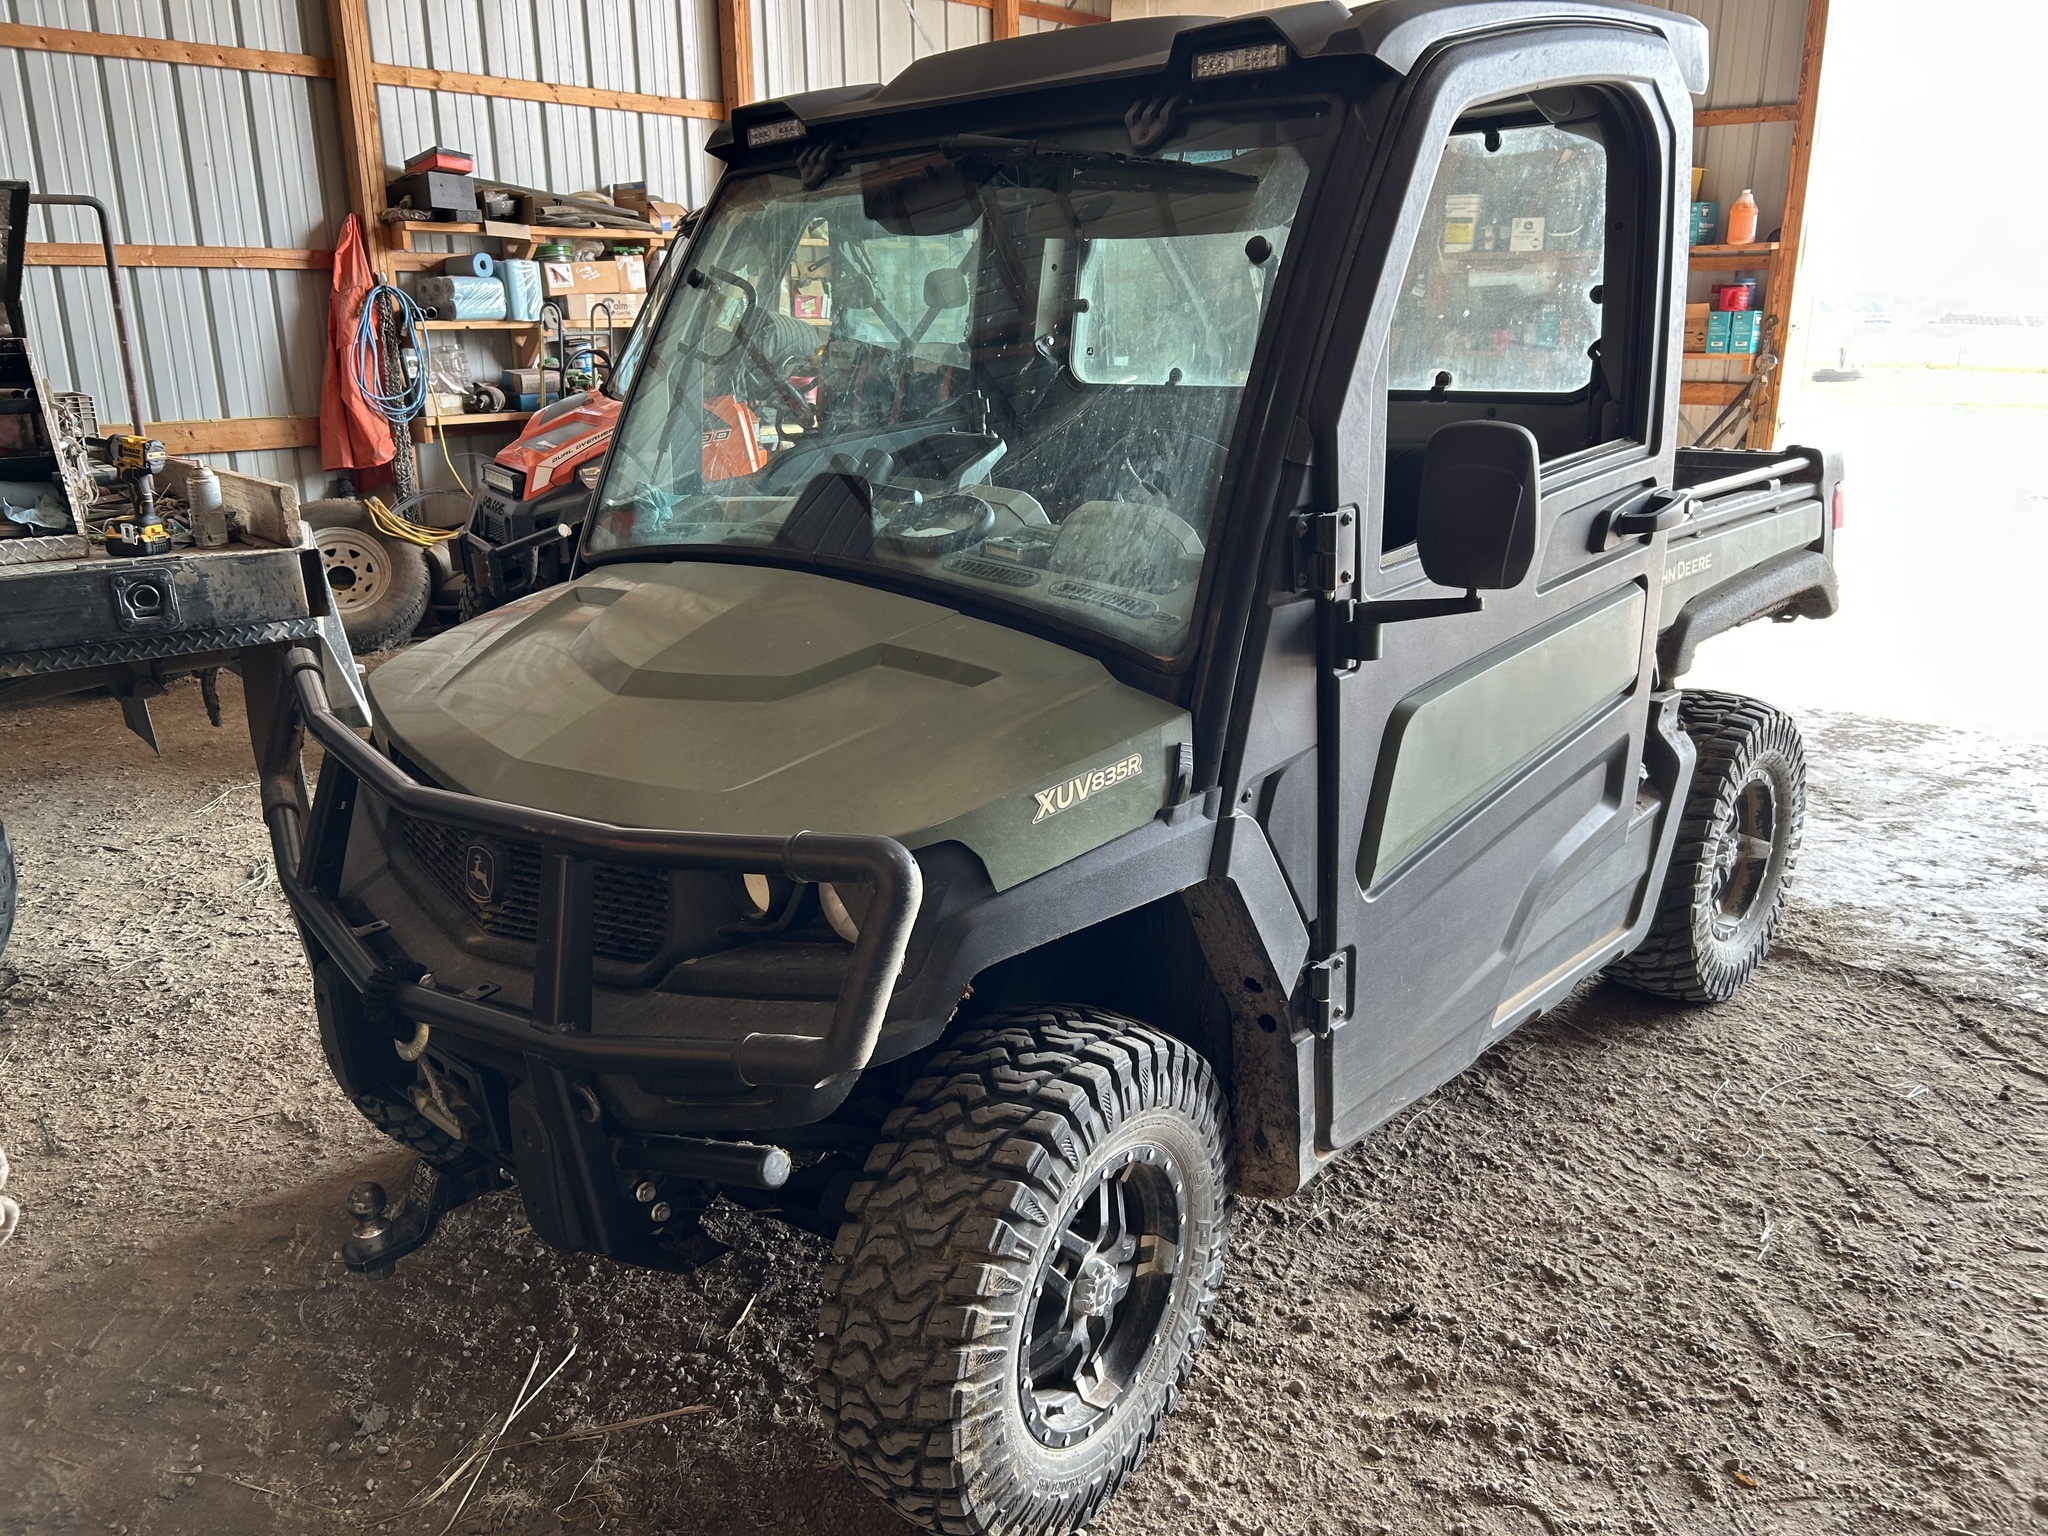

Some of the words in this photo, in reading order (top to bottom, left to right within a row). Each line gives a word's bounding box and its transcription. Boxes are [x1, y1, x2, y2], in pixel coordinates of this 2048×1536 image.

[551, 449, 574, 463] DUAL
[1677, 553, 1712, 580] DEERE
[1033, 754, 1142, 823] XUV835R
